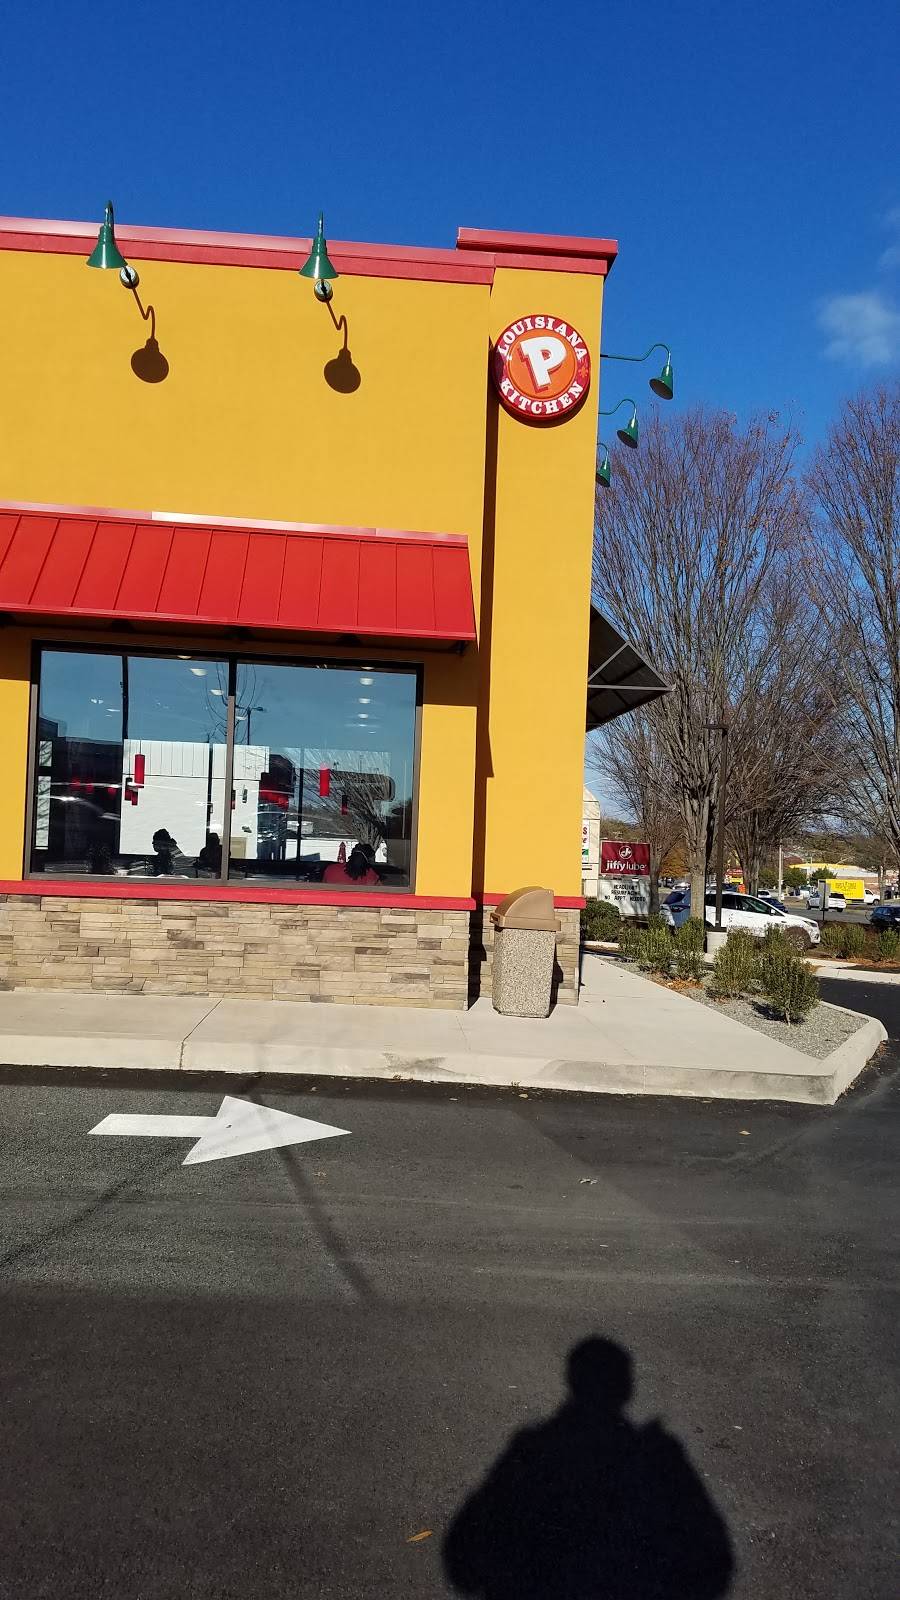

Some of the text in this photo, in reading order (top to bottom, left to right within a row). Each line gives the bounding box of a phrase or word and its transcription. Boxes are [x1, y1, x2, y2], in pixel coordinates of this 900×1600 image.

[497, 316, 588, 361] LOUISIANA
[519, 336, 568, 387] P
[500, 377, 584, 414] KITCHEN
[605, 860, 645, 871] jiffy lube
